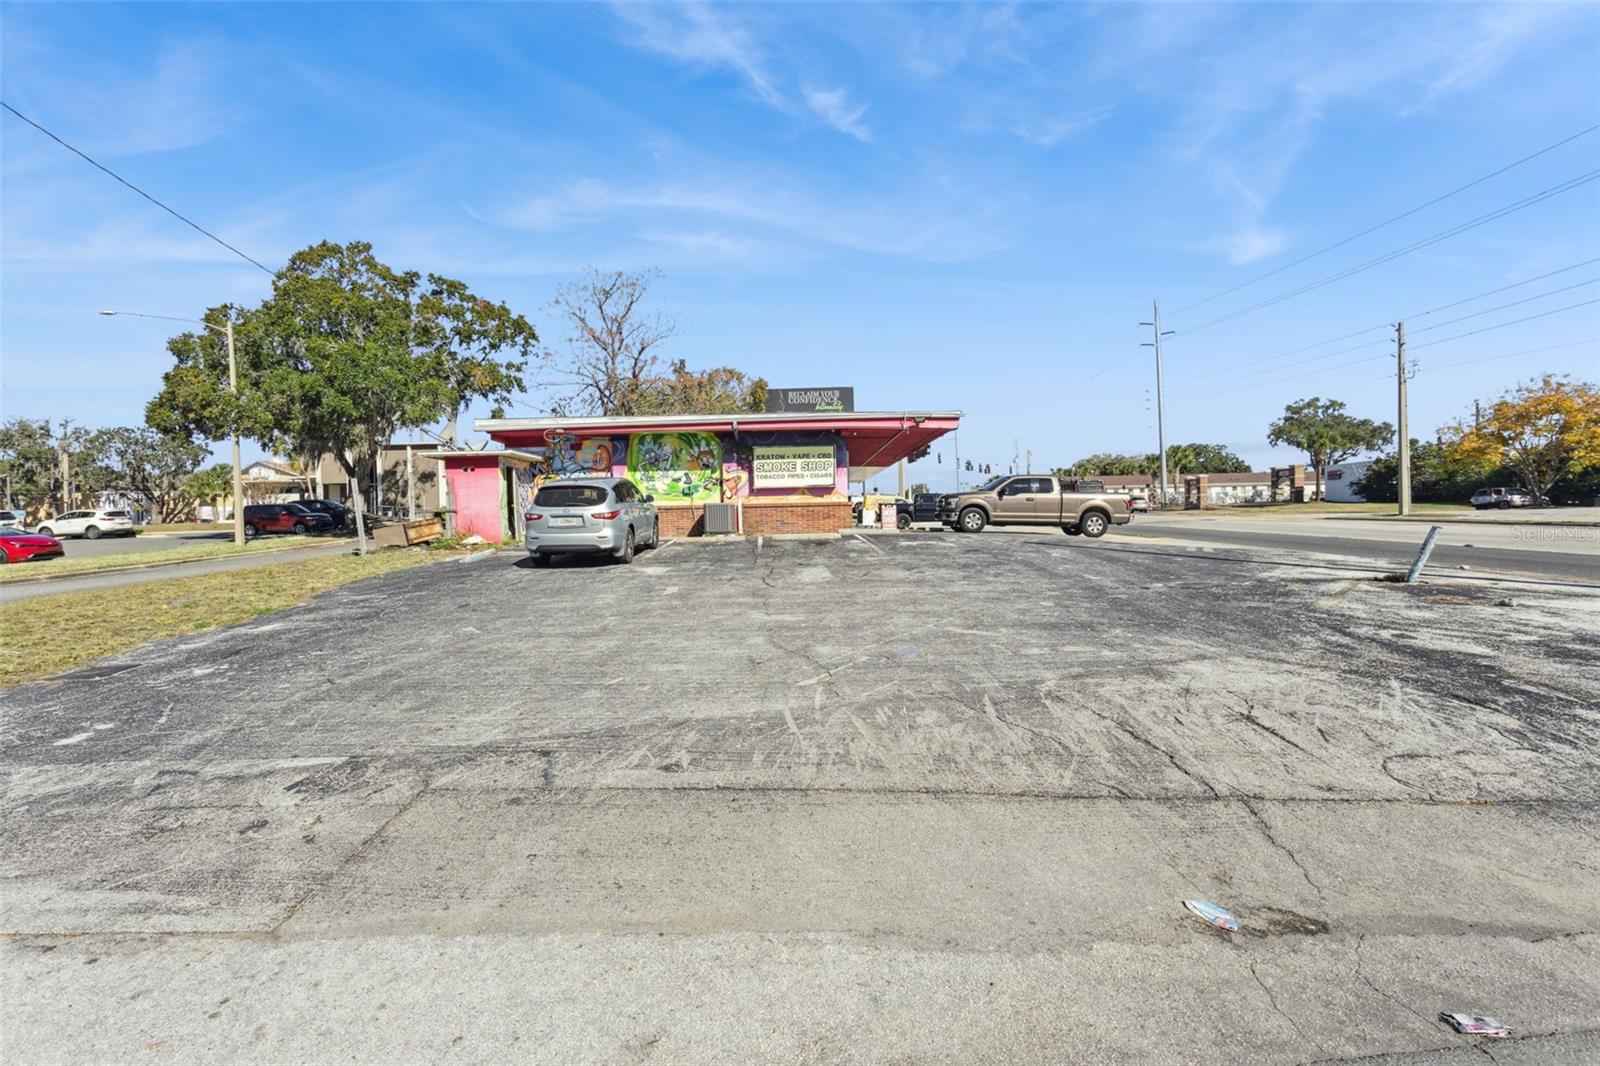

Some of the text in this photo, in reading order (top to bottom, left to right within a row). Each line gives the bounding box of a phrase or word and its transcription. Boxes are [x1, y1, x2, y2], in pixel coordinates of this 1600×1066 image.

[788, 396, 838, 404] CONFIDENCE
[756, 461, 832, 472] SMOKE SHOP
